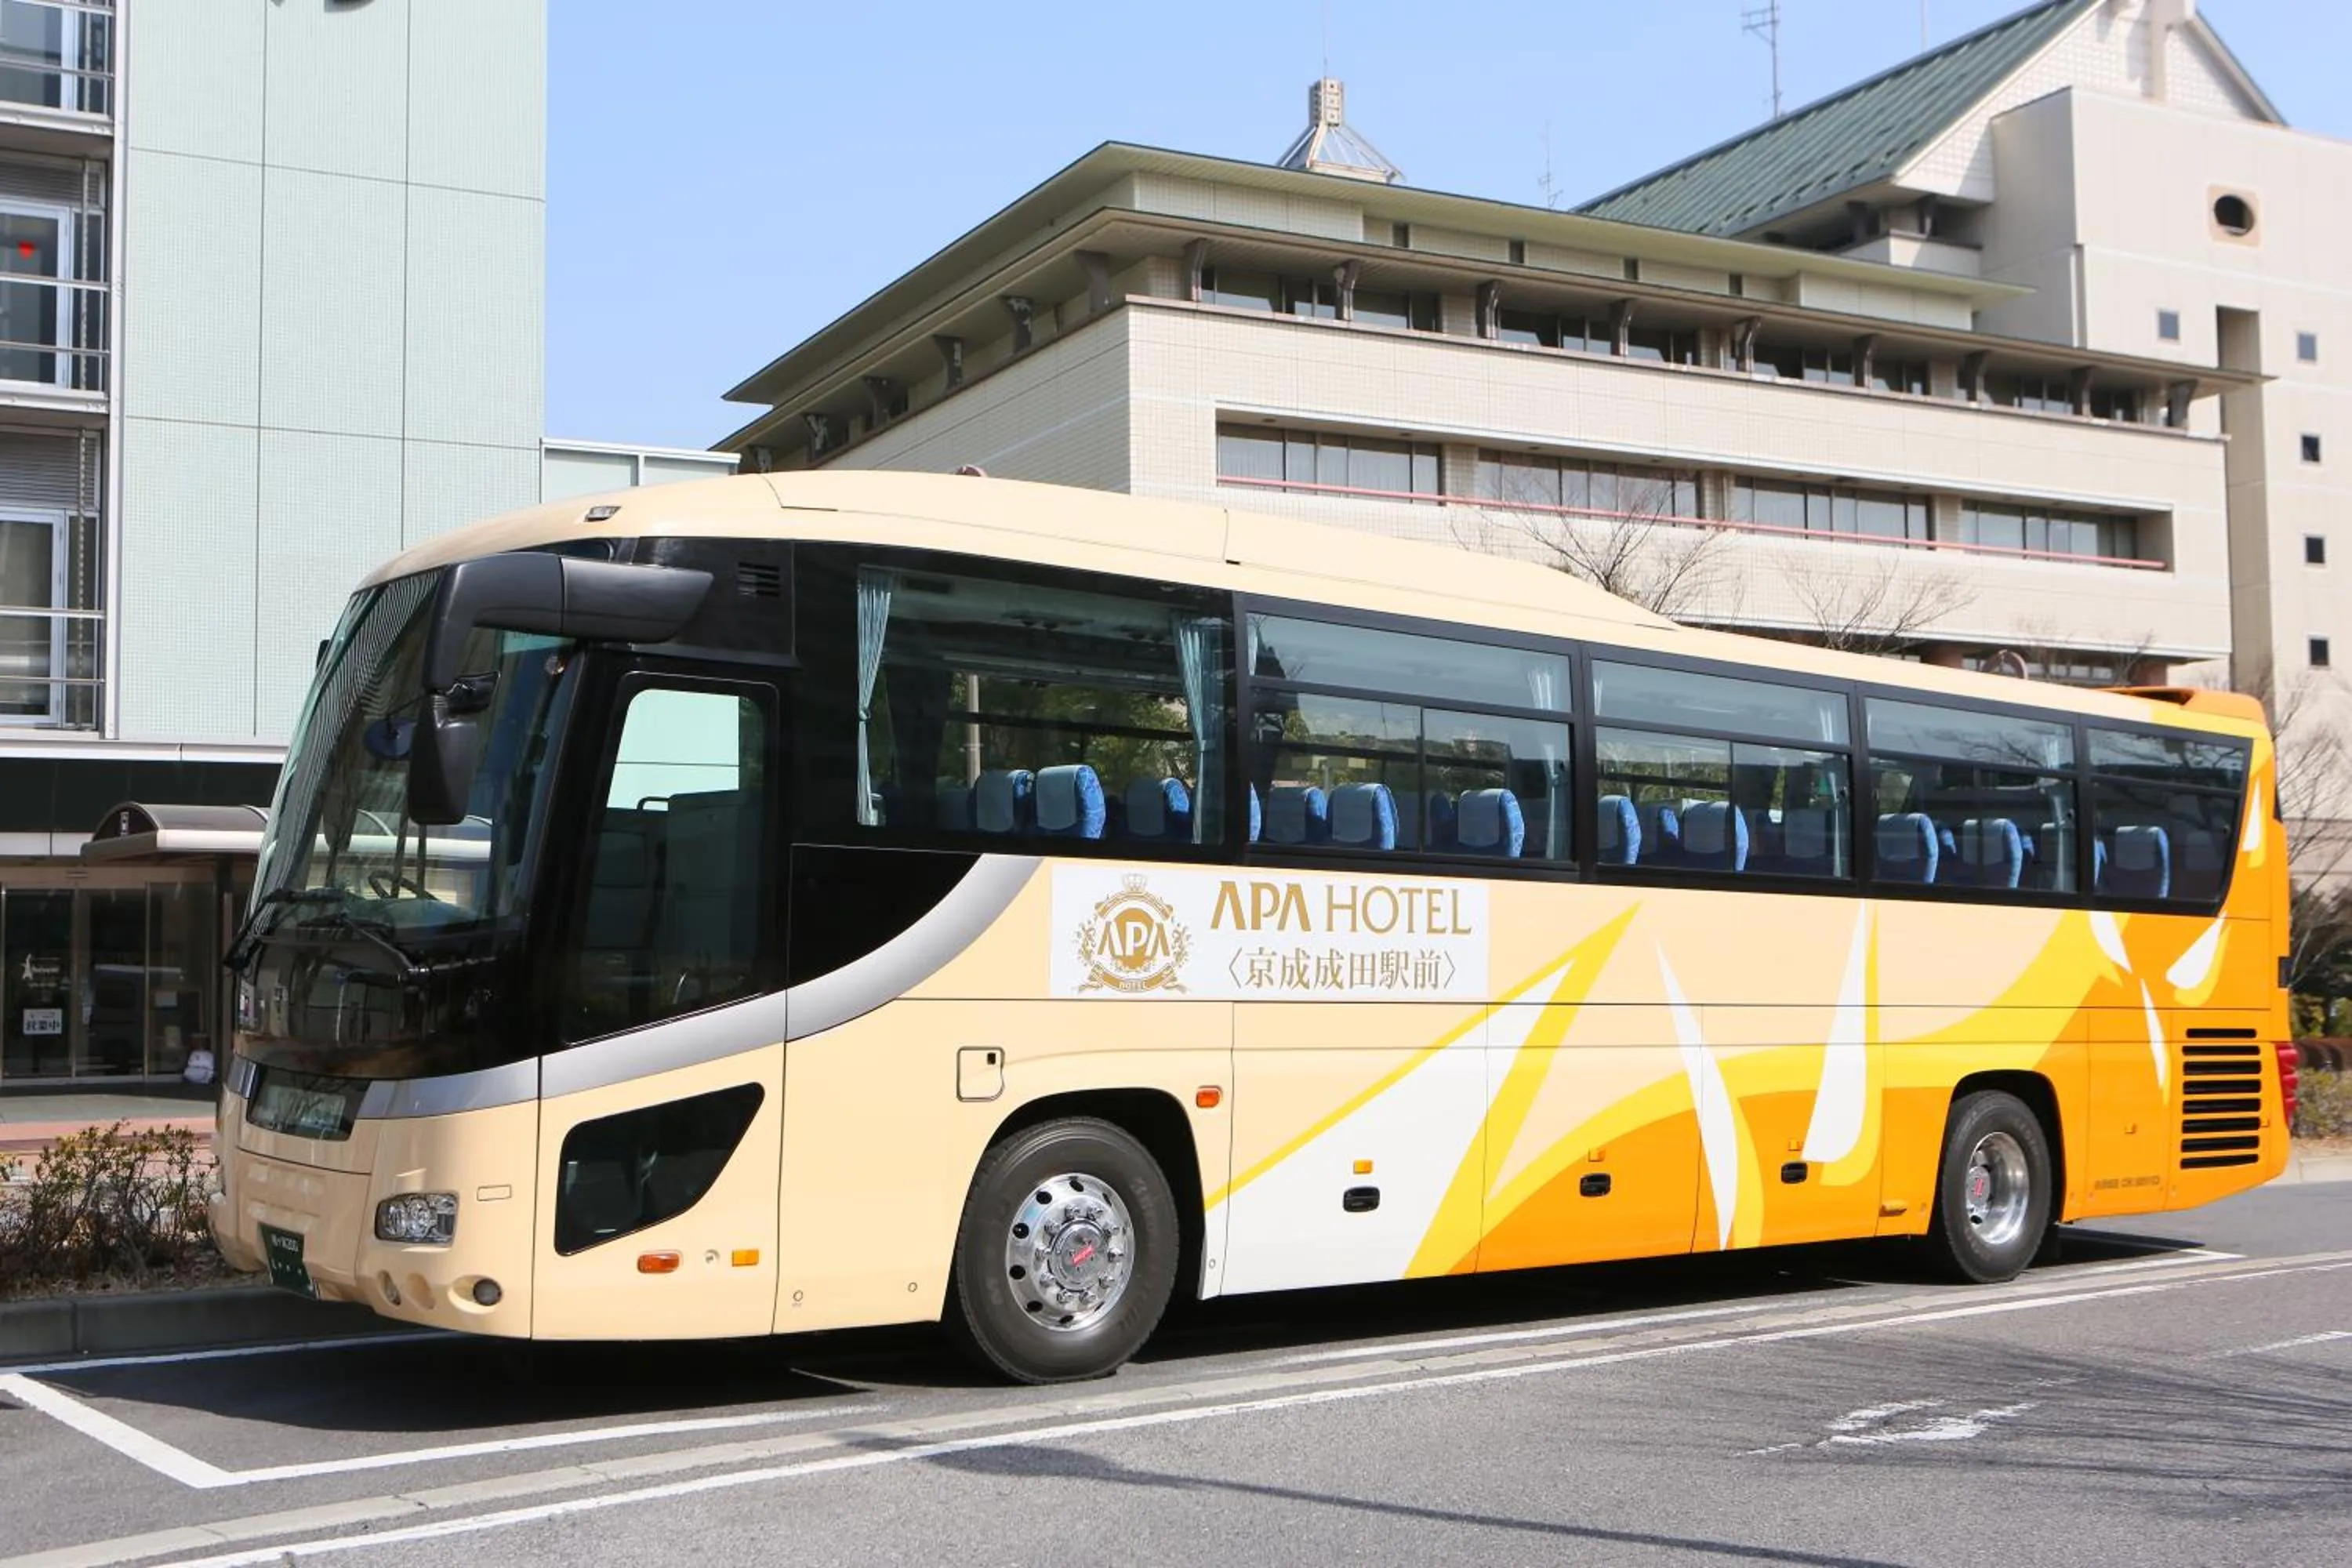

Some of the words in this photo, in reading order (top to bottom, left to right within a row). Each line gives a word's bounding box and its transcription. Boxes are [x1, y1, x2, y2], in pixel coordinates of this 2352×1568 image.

[1210, 880, 1311, 931] APA
[1326, 885, 1472, 935] HOTEL
[1098, 920, 1171, 957] APA
